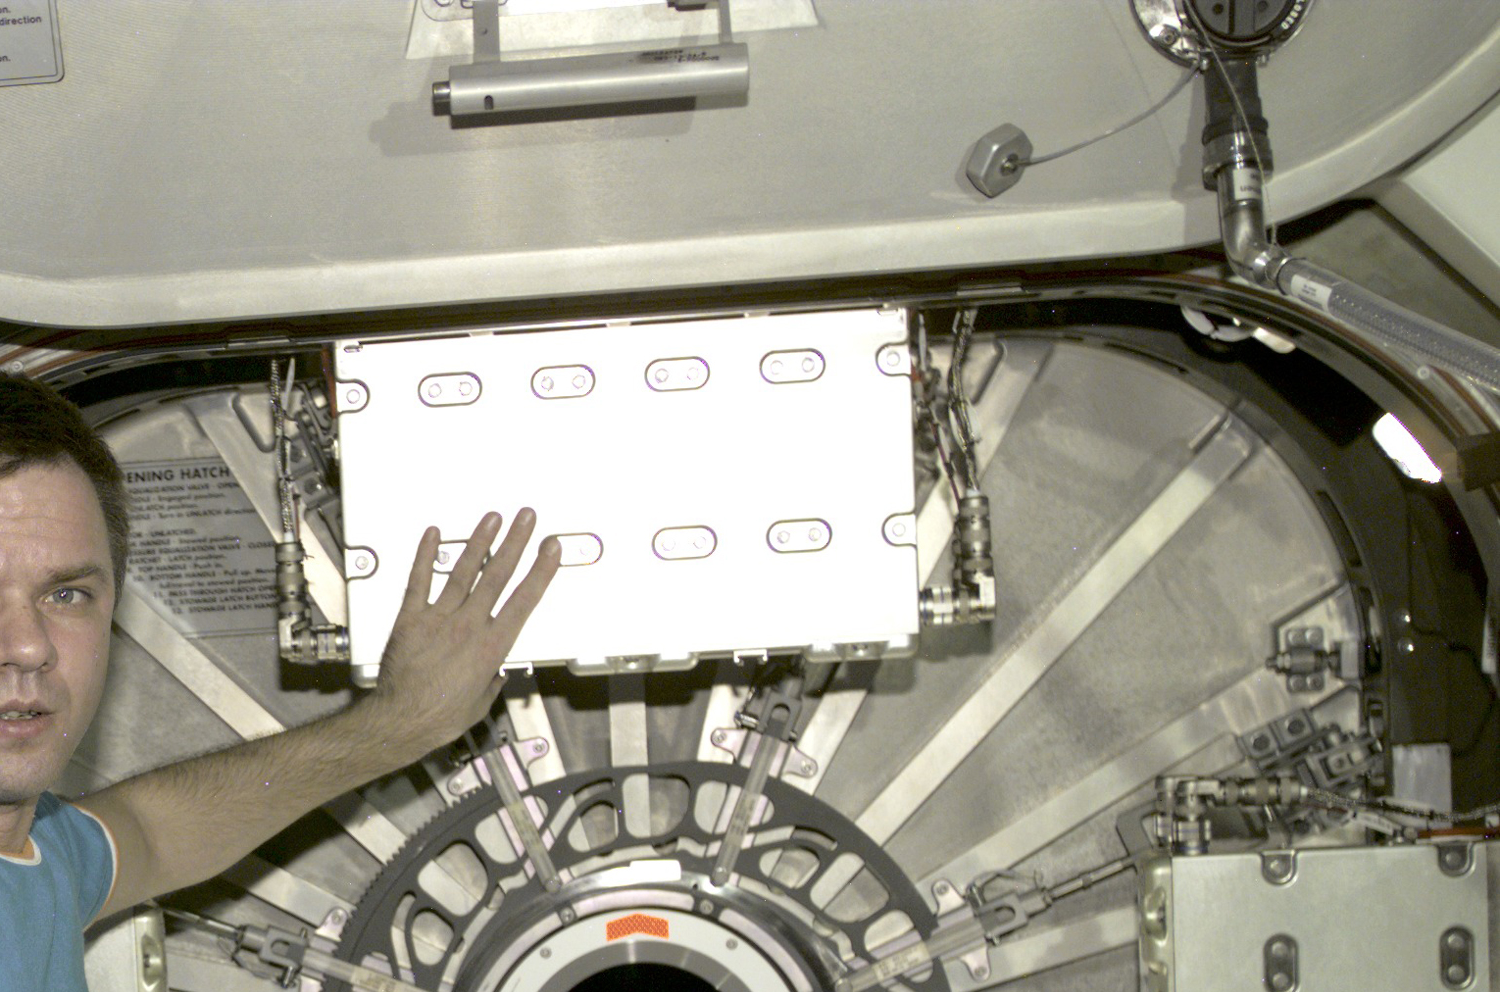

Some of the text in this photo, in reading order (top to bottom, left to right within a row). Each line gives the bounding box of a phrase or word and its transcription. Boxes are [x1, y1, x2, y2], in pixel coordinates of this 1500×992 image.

[0, 16, 42, 26] direction
[127, 466, 230, 483] ENING HATCH
[129, 485, 184, 494] QUALIZATION
